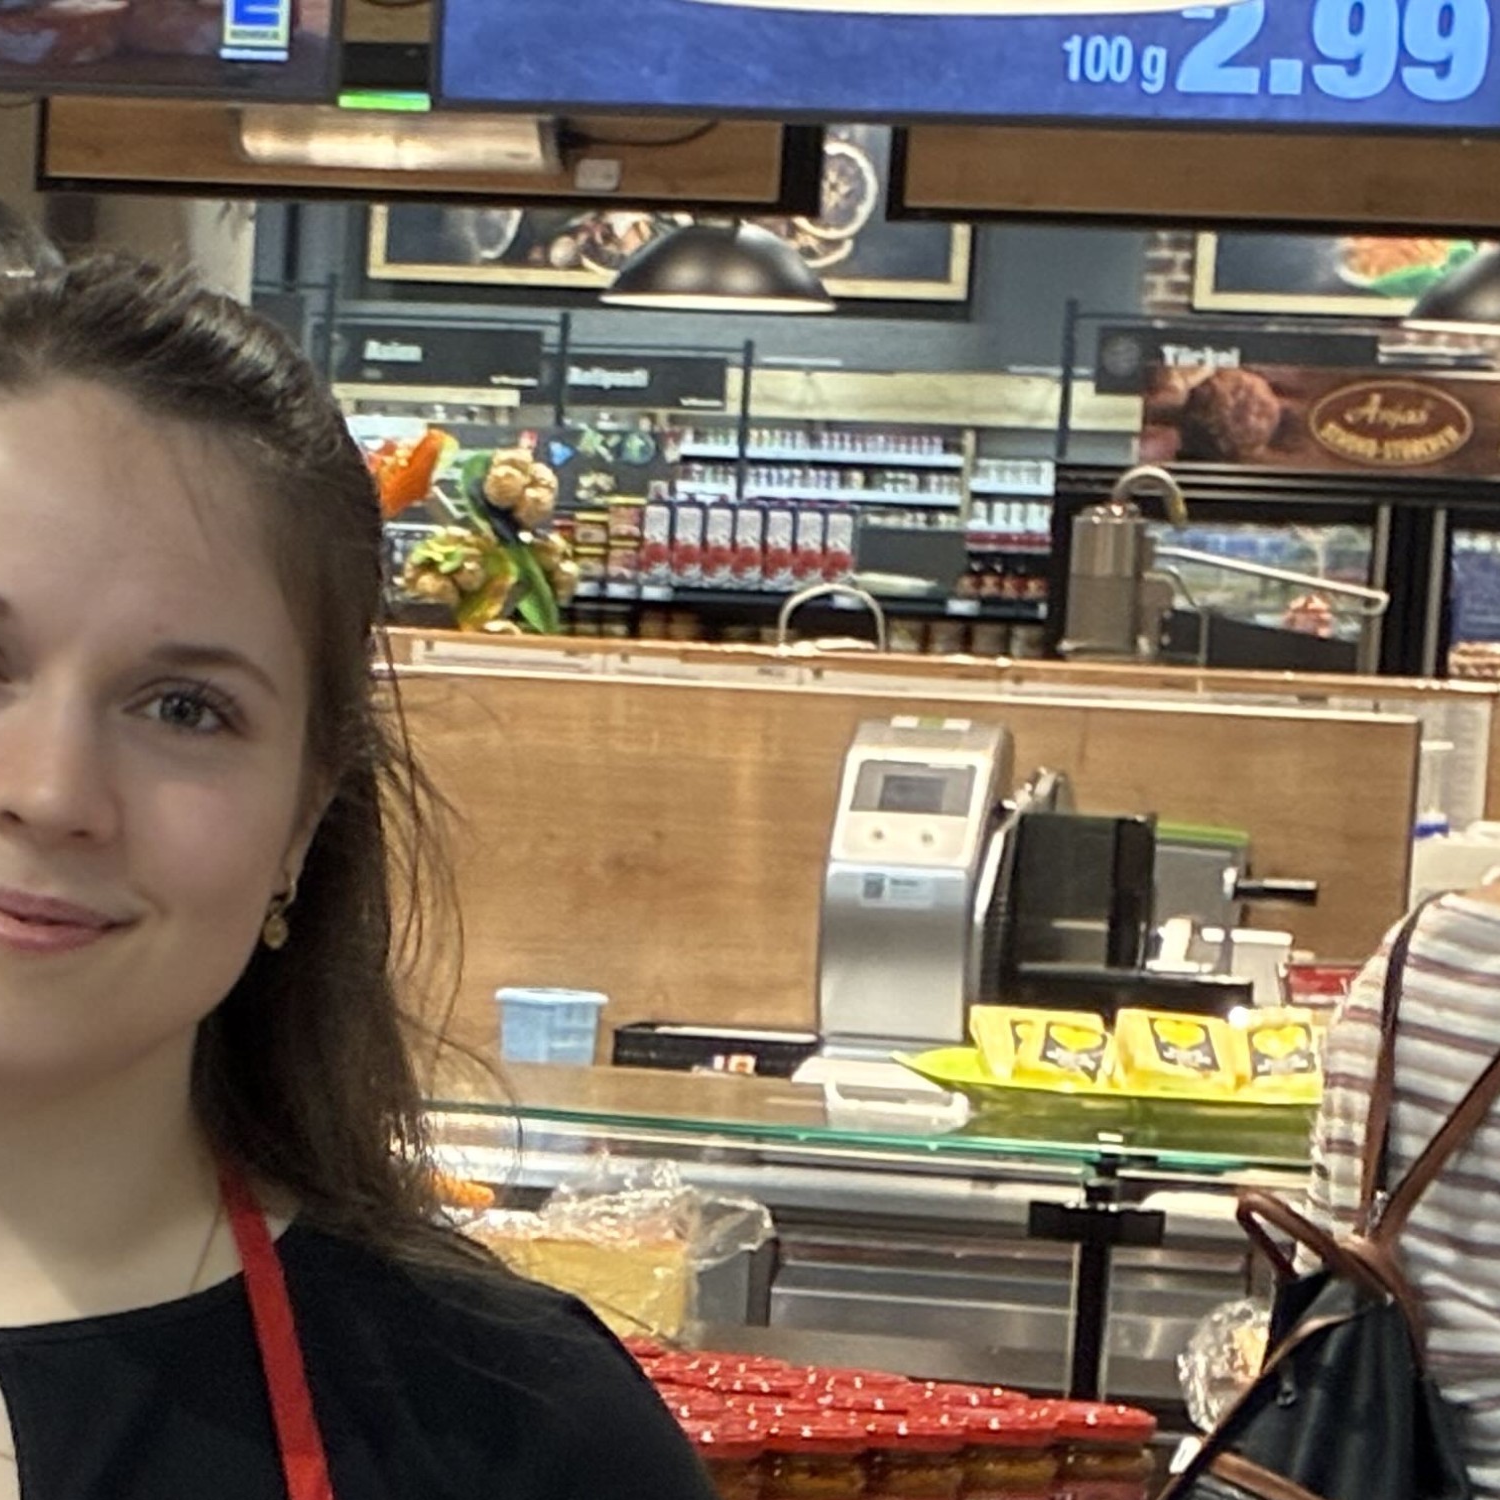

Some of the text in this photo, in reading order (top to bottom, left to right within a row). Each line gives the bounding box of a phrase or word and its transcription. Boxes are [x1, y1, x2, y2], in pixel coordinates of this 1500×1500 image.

[1063, 0, 1491, 101] 100 g 2.99
